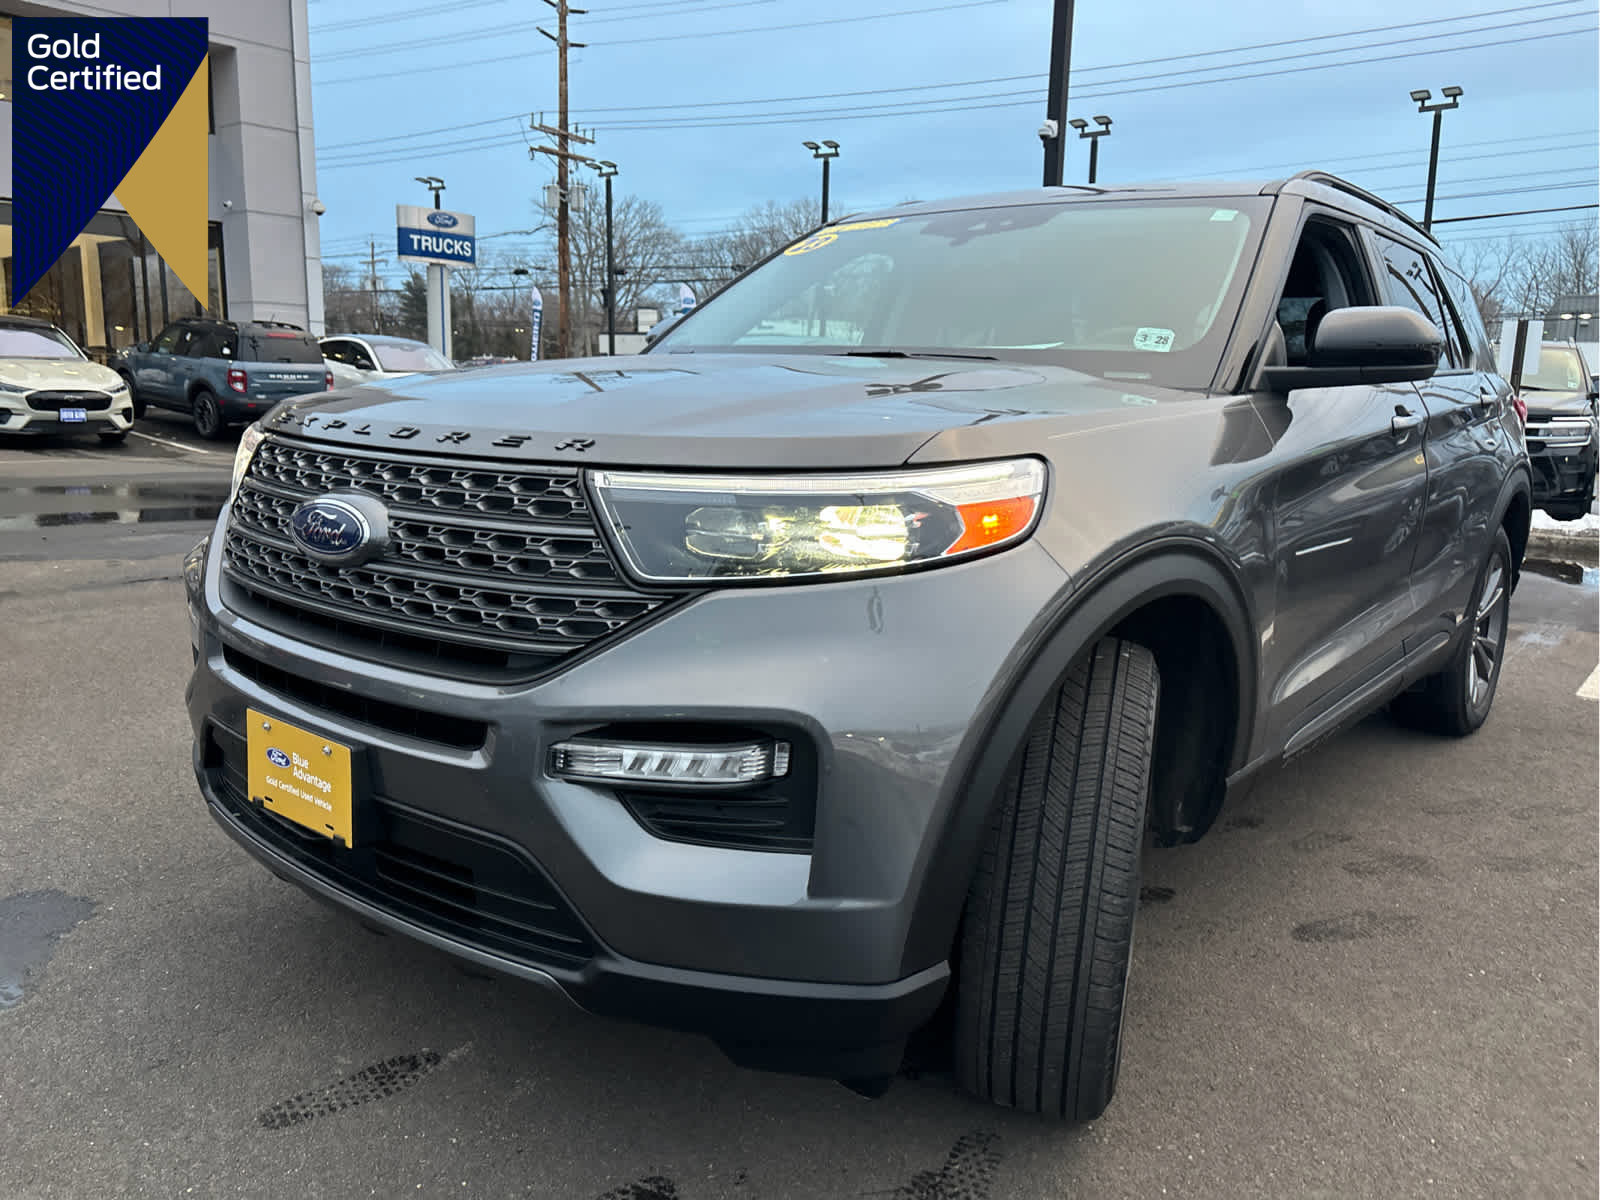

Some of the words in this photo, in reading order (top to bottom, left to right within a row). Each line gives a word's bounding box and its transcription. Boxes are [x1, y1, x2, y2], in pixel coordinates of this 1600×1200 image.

[409, 234, 472, 257] TRUCKS
[269, 749, 288, 767] Ford
[292, 751, 309, 769] Blue
[265, 775, 278, 788] Gold
[278, 780, 300, 797] Certified
[300, 789, 313, 803] Used
[293, 765, 332, 793] Advantage
